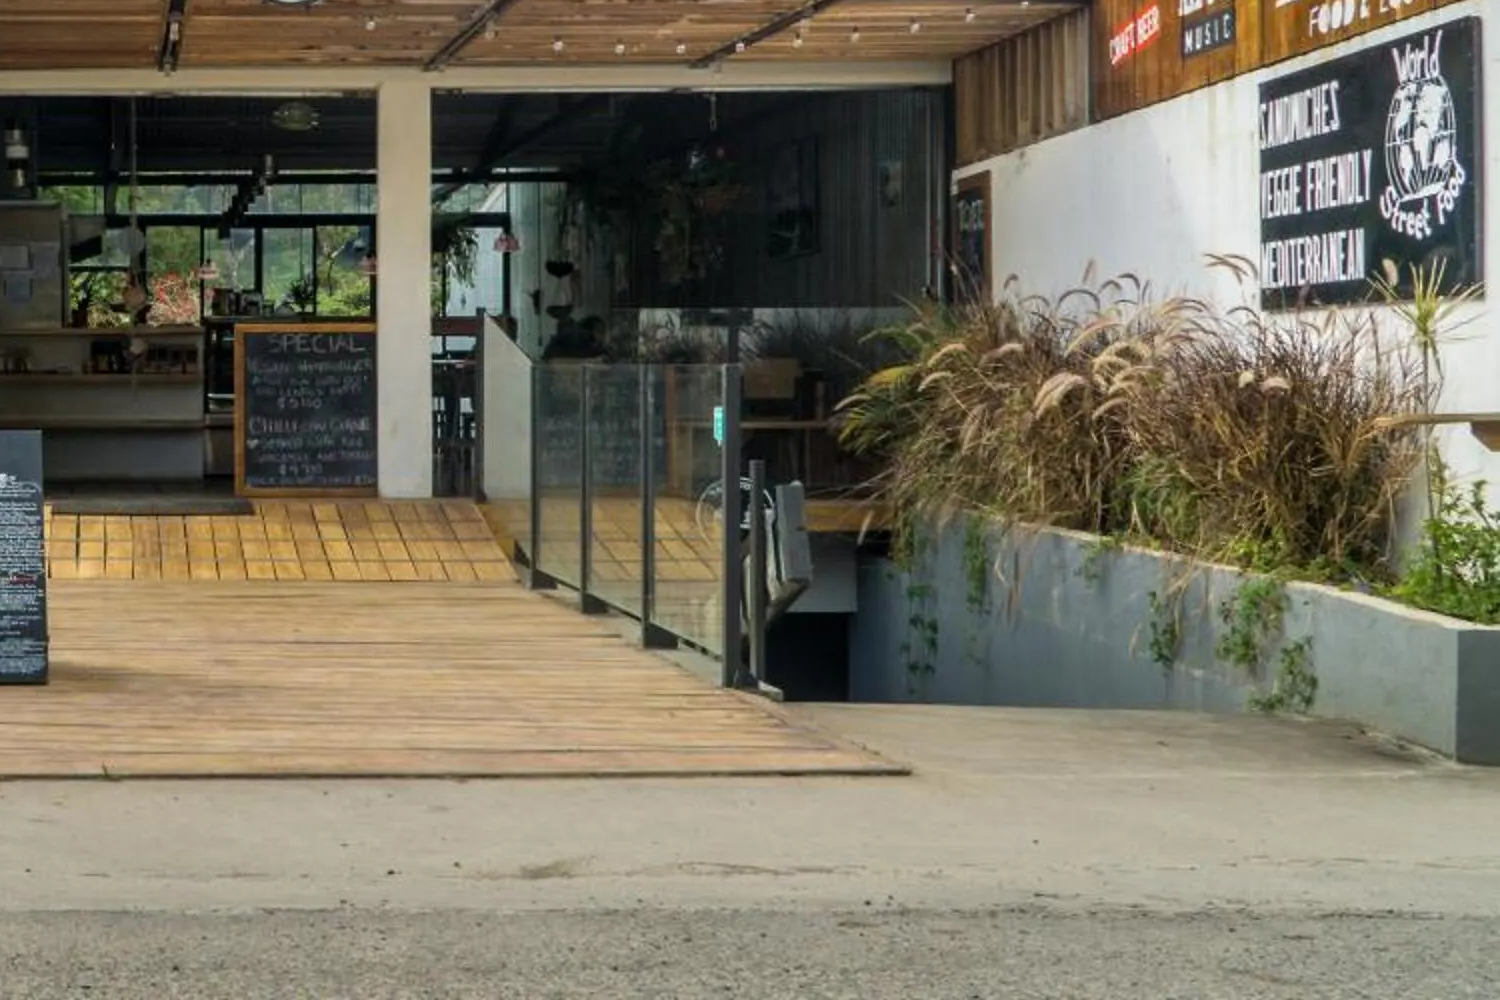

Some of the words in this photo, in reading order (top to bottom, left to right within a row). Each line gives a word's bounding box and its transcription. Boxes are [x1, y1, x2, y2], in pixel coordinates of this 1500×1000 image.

[1184, 13, 1232, 54] MUSIC
[1391, 29, 1443, 81] World
[1306, 149, 1373, 212] FRIENDLY
[1380, 185, 1431, 239] Street
[267, 333, 366, 353] SPECIAL
